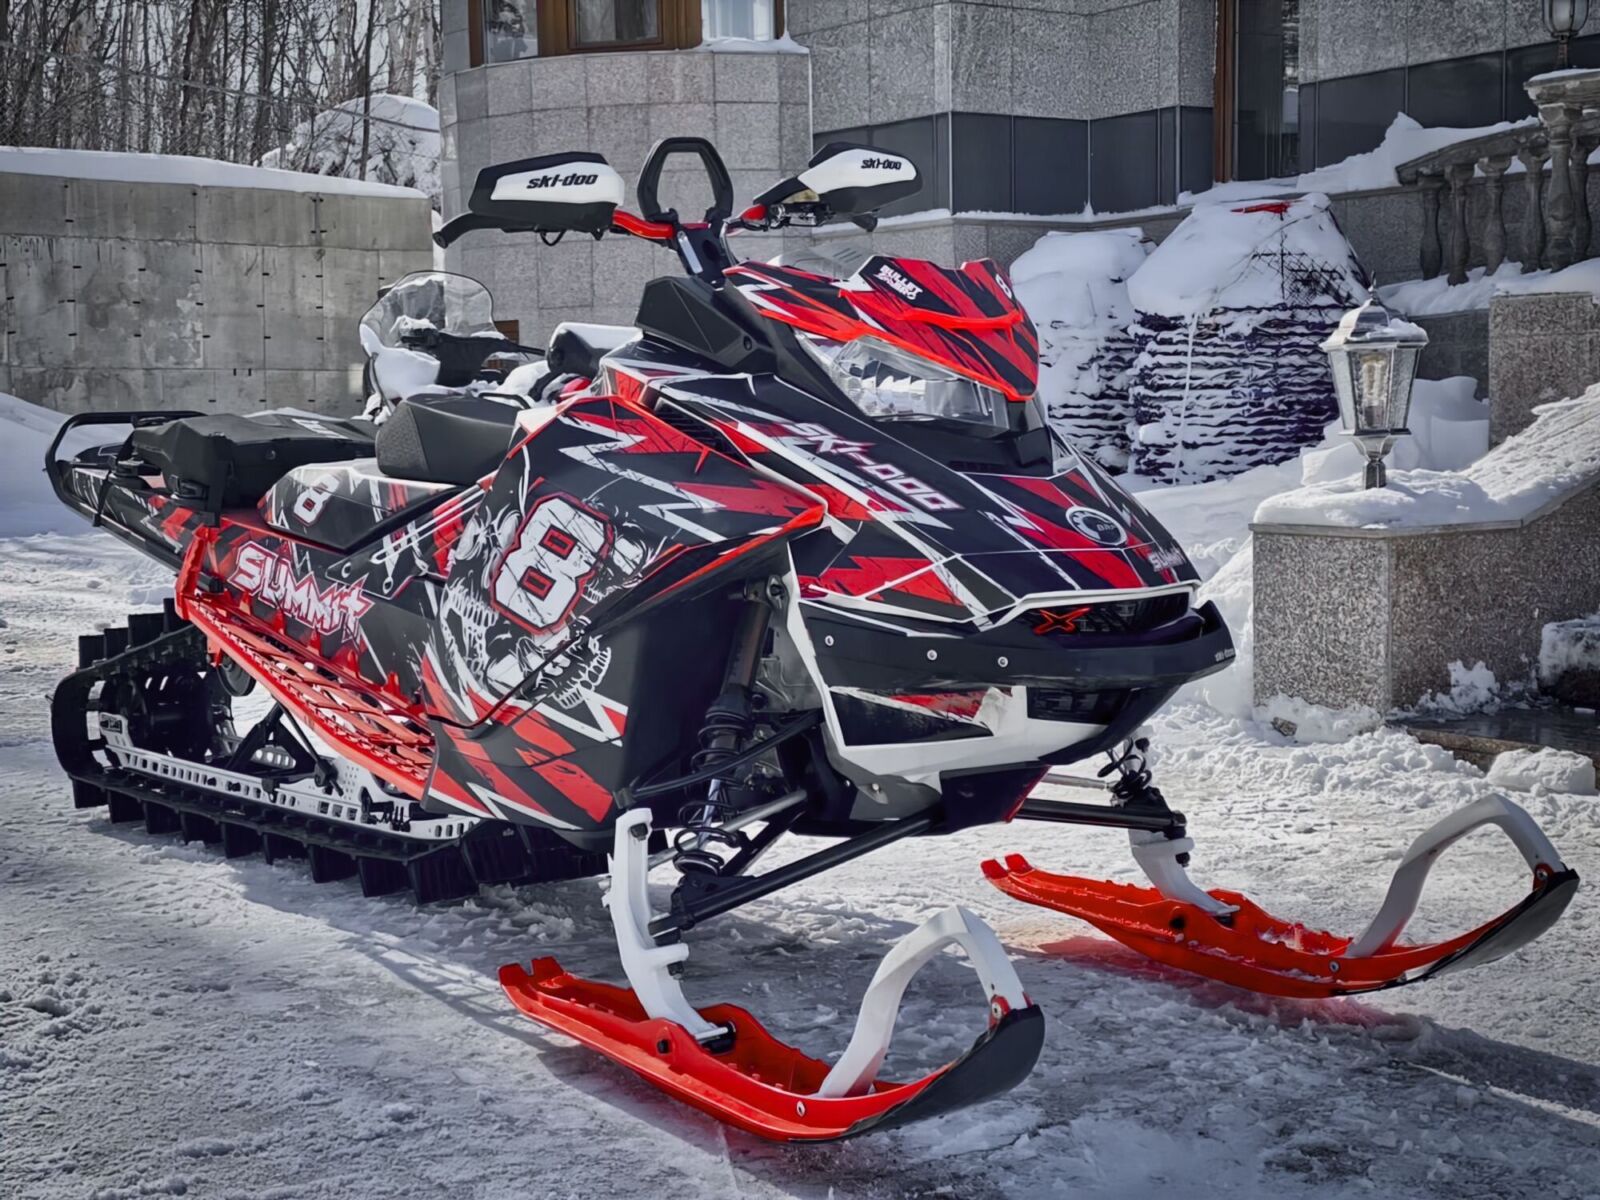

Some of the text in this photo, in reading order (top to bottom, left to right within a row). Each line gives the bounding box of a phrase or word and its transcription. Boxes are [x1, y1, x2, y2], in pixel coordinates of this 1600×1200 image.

[860, 158, 902, 170] ski-doo
[526, 173, 599, 189] ski-doo
[494, 496, 608, 630] 8
